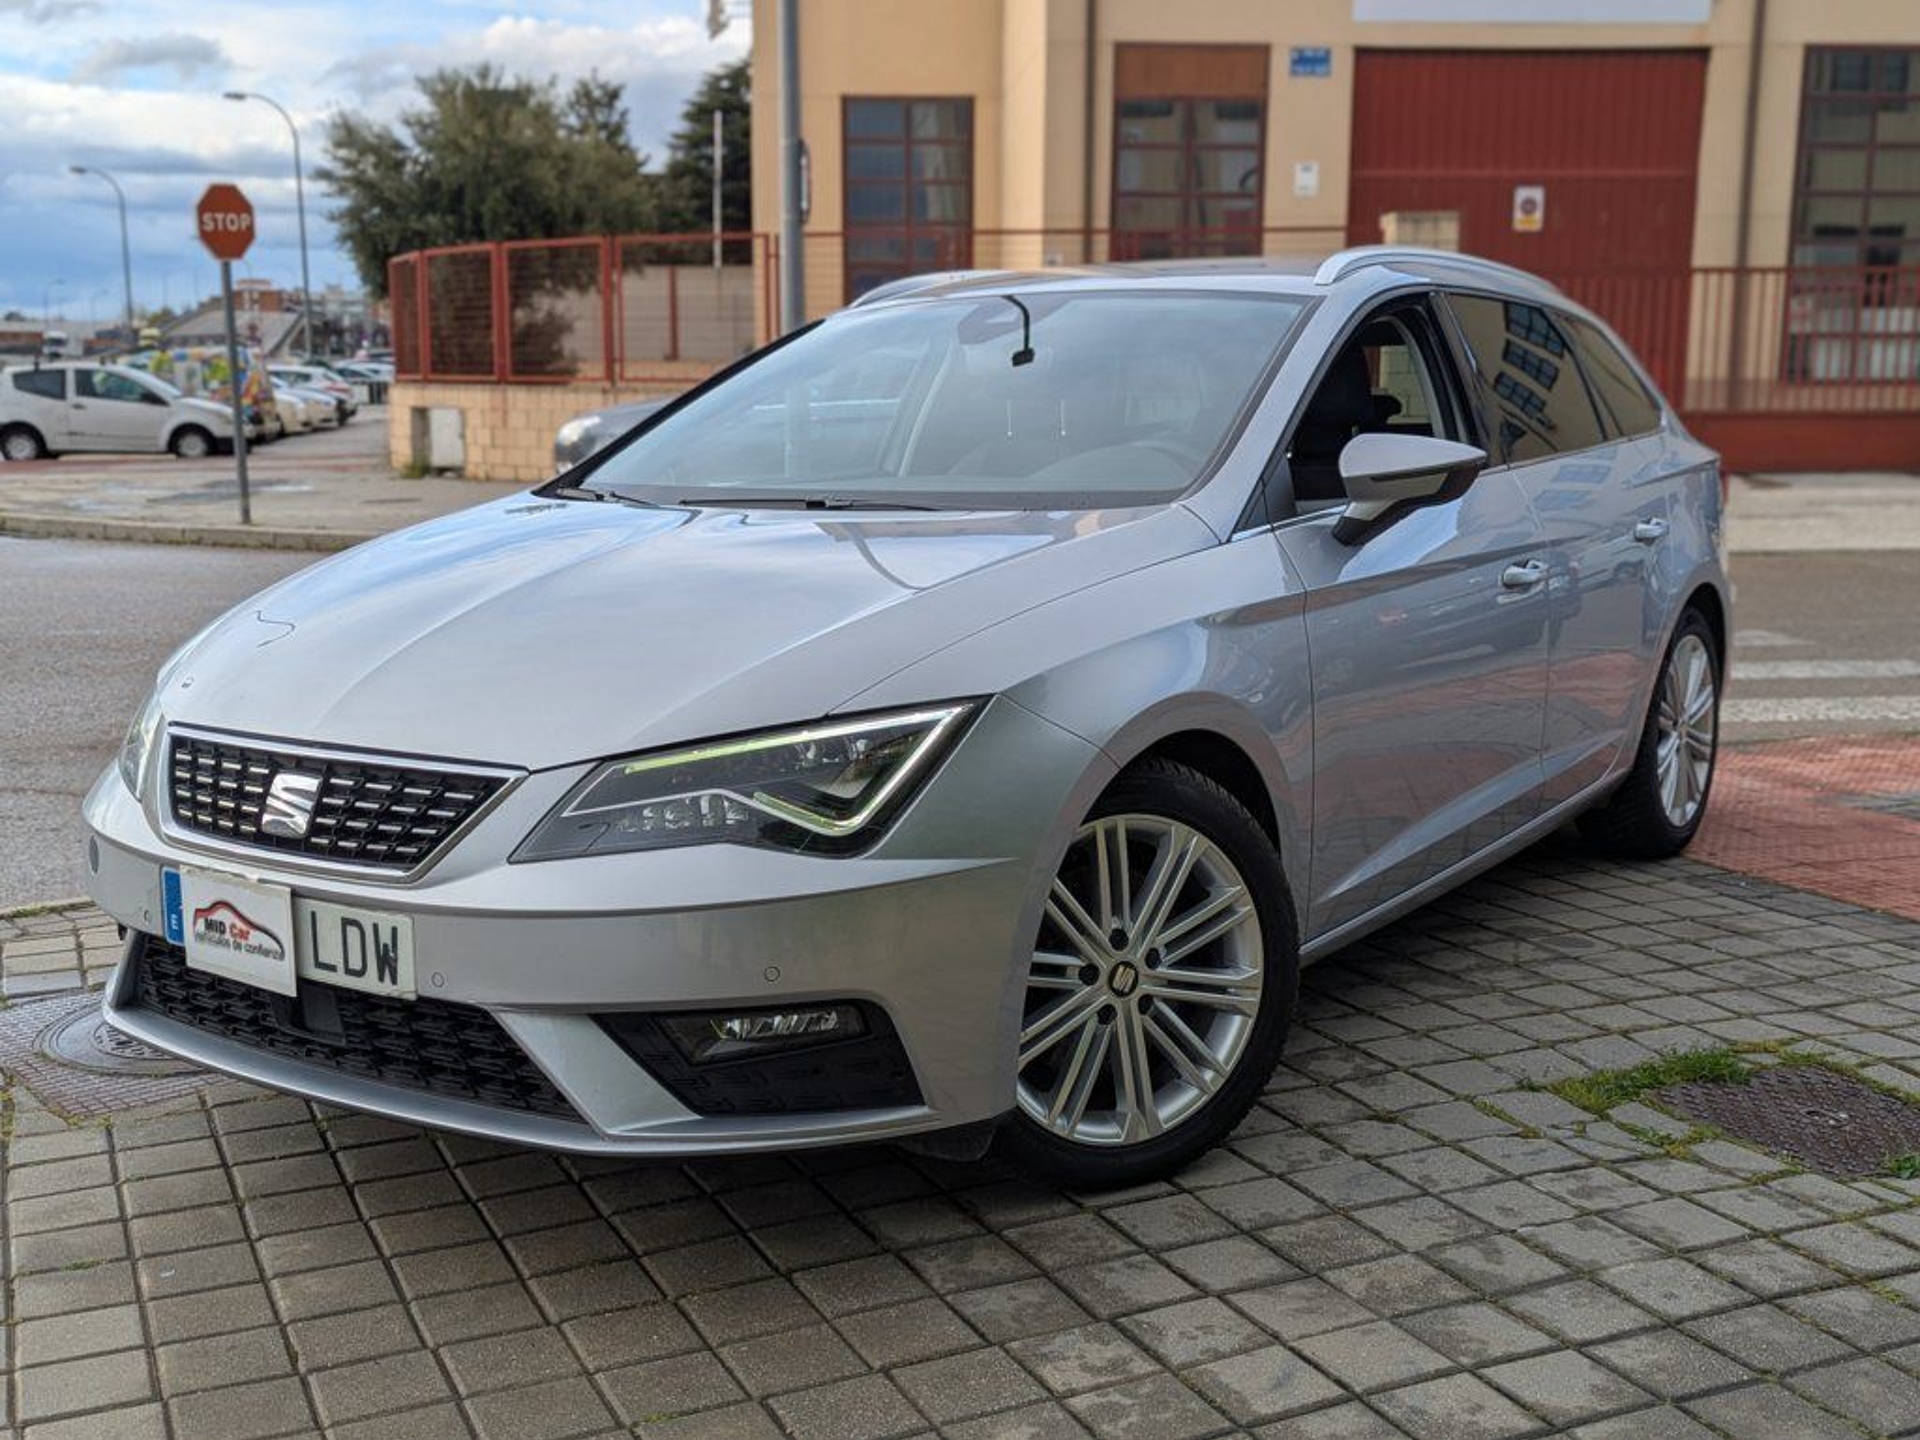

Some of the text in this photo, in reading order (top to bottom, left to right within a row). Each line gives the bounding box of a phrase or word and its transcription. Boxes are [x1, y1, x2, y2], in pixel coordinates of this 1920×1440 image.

[202, 211, 251, 232] STOP
[203, 916, 249, 941] MID Car
[310, 909, 399, 986] LDW
